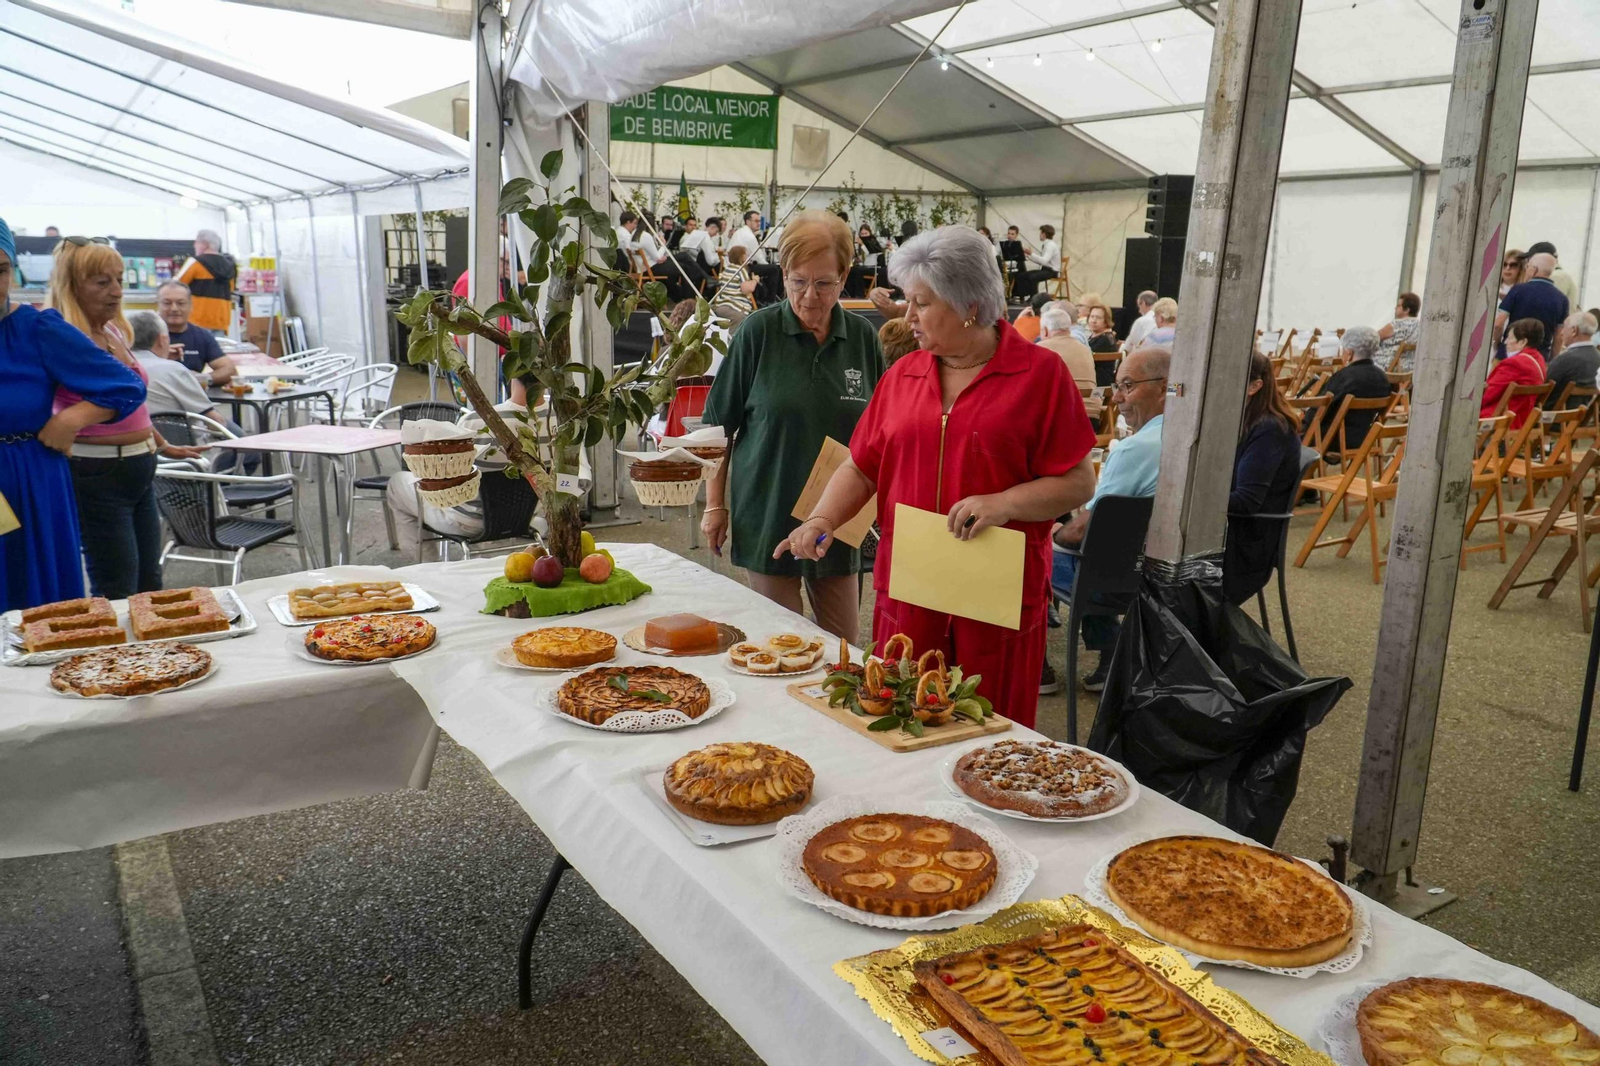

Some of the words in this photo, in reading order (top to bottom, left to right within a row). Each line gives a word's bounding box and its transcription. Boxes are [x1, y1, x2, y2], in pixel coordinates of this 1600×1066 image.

[663, 94, 713, 114] LOCAL
[716, 98, 770, 118] MENOR
[624, 116, 645, 135] DE
[652, 118, 733, 140] BEMBRIVE
[939, 1034, 957, 1047] 19
